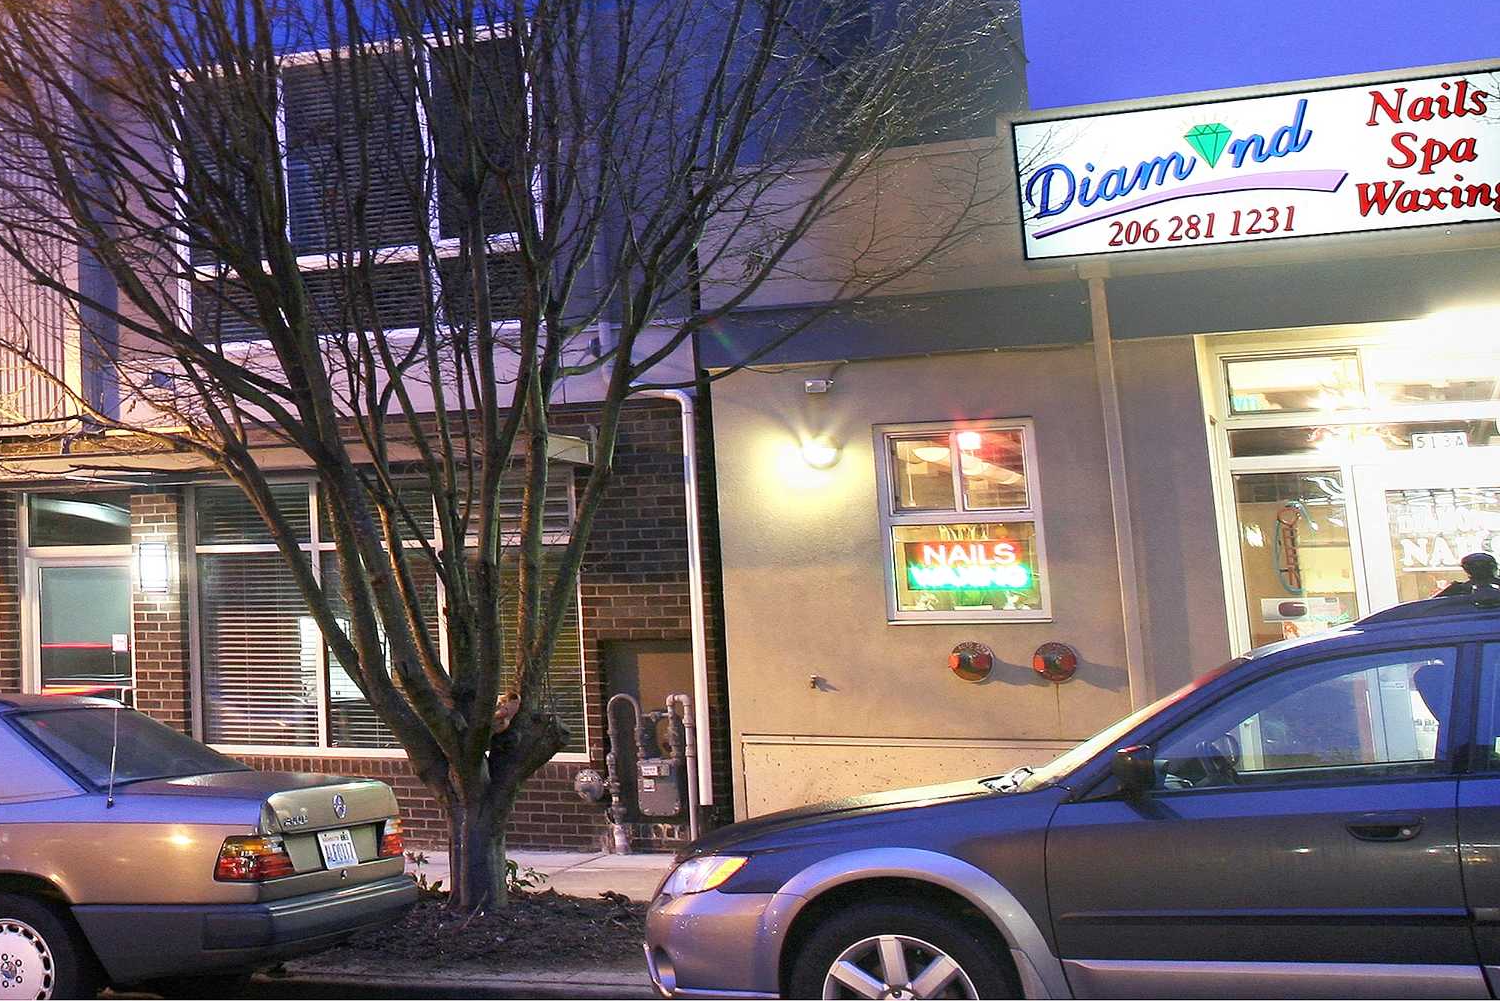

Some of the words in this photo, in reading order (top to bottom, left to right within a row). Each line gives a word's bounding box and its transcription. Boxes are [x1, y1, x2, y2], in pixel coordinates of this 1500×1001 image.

[1366, 80, 1488, 126] Nails
[1387, 132, 1478, 175] Spa
[1108, 219, 1160, 246] 206
[1167, 212, 1215, 241] 281
[1230, 205, 1295, 236] 1231
[922, 543, 1016, 566] NAILS
